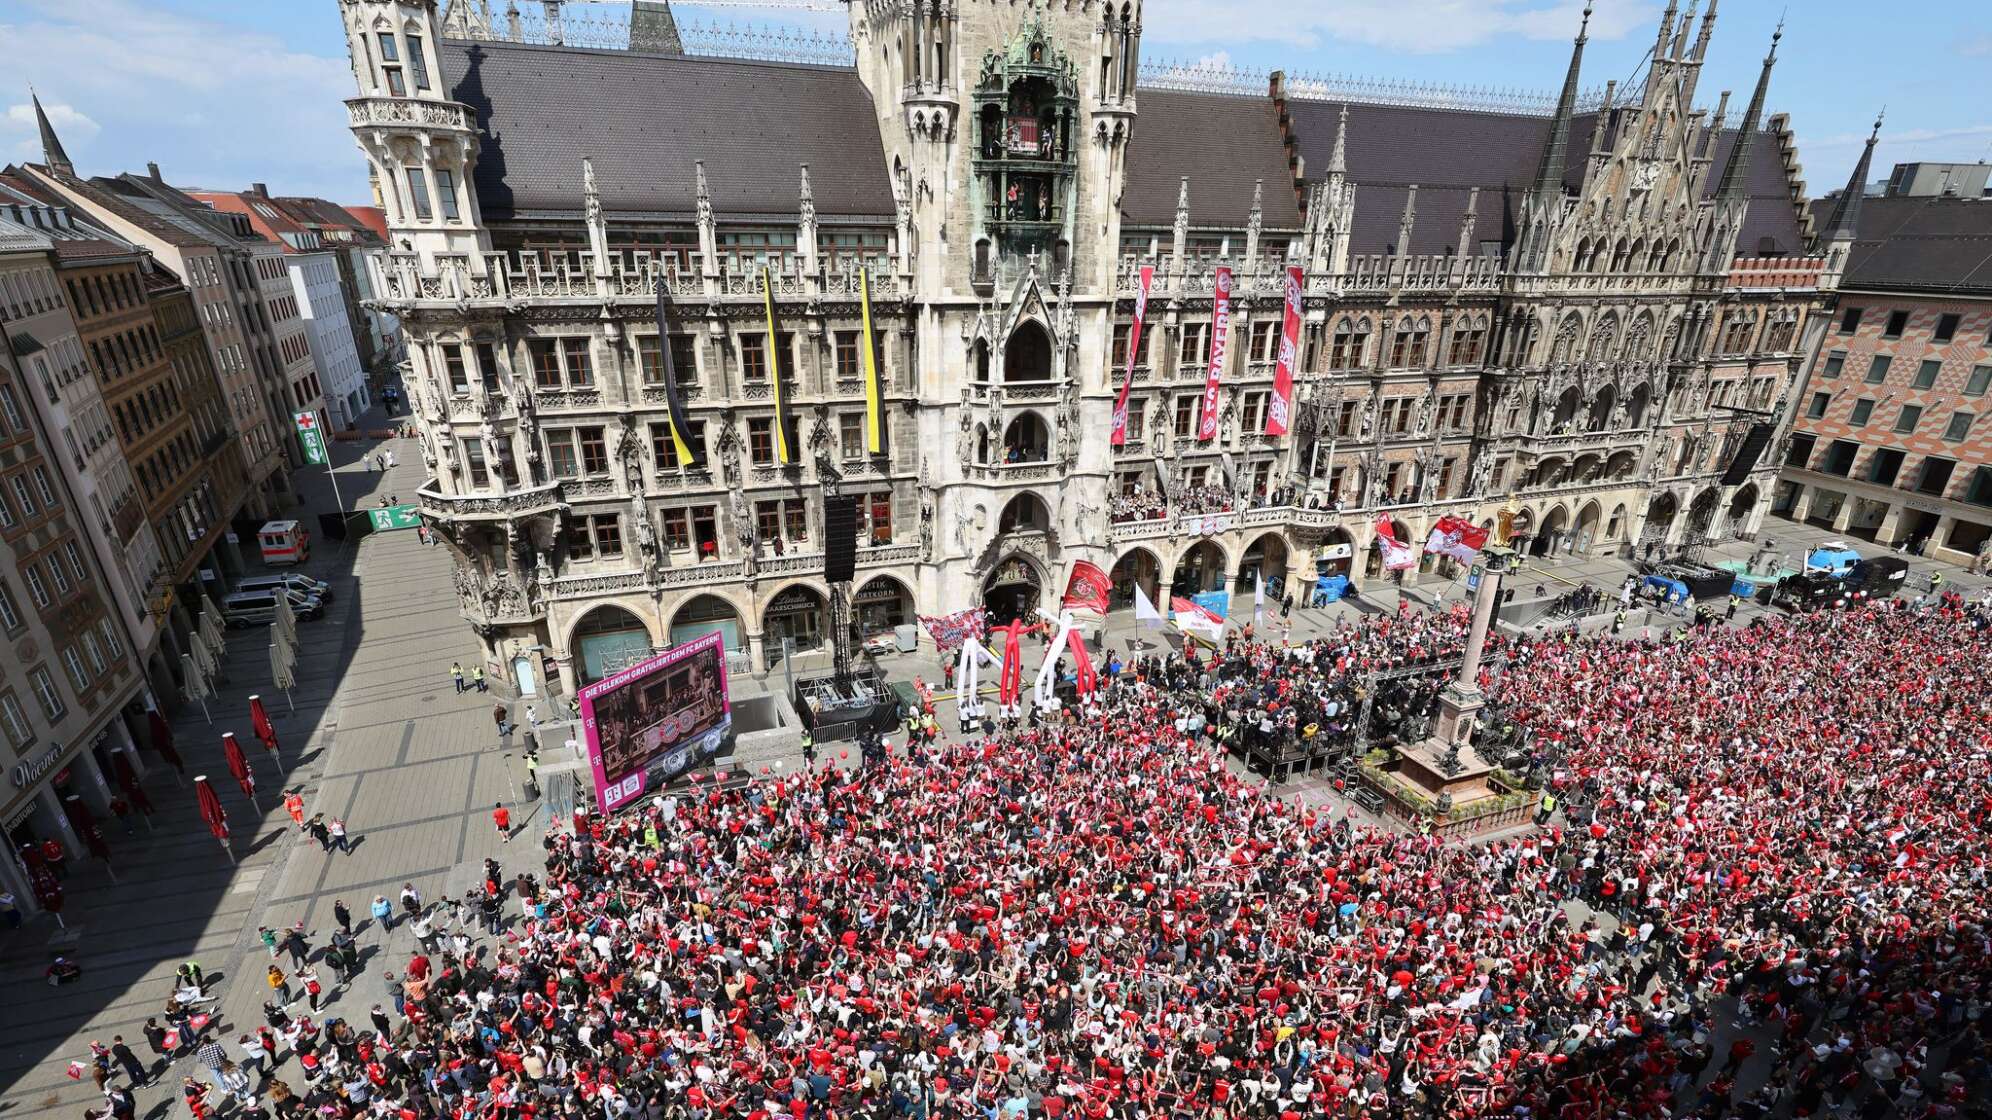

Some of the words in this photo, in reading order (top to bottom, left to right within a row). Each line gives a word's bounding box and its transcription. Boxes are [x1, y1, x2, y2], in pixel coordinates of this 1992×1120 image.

[1210, 300, 1230, 381] BAYERN
[1205, 387, 1217, 412] FC
[1472, 566, 1479, 575] S
[1470, 575, 1477, 585] U
[585, 688, 598, 699] DIE
[598, 673, 632, 695] TELEKOM
[631, 656, 671, 679] GRATULIERT
[671, 649, 687, 661] DEM
[686, 644, 696, 654] FC
[694, 634, 721, 651] BAYERN!
[586, 718, 595, 729] T
[593, 755, 602, 766] T
[607, 786, 620, 802] T
